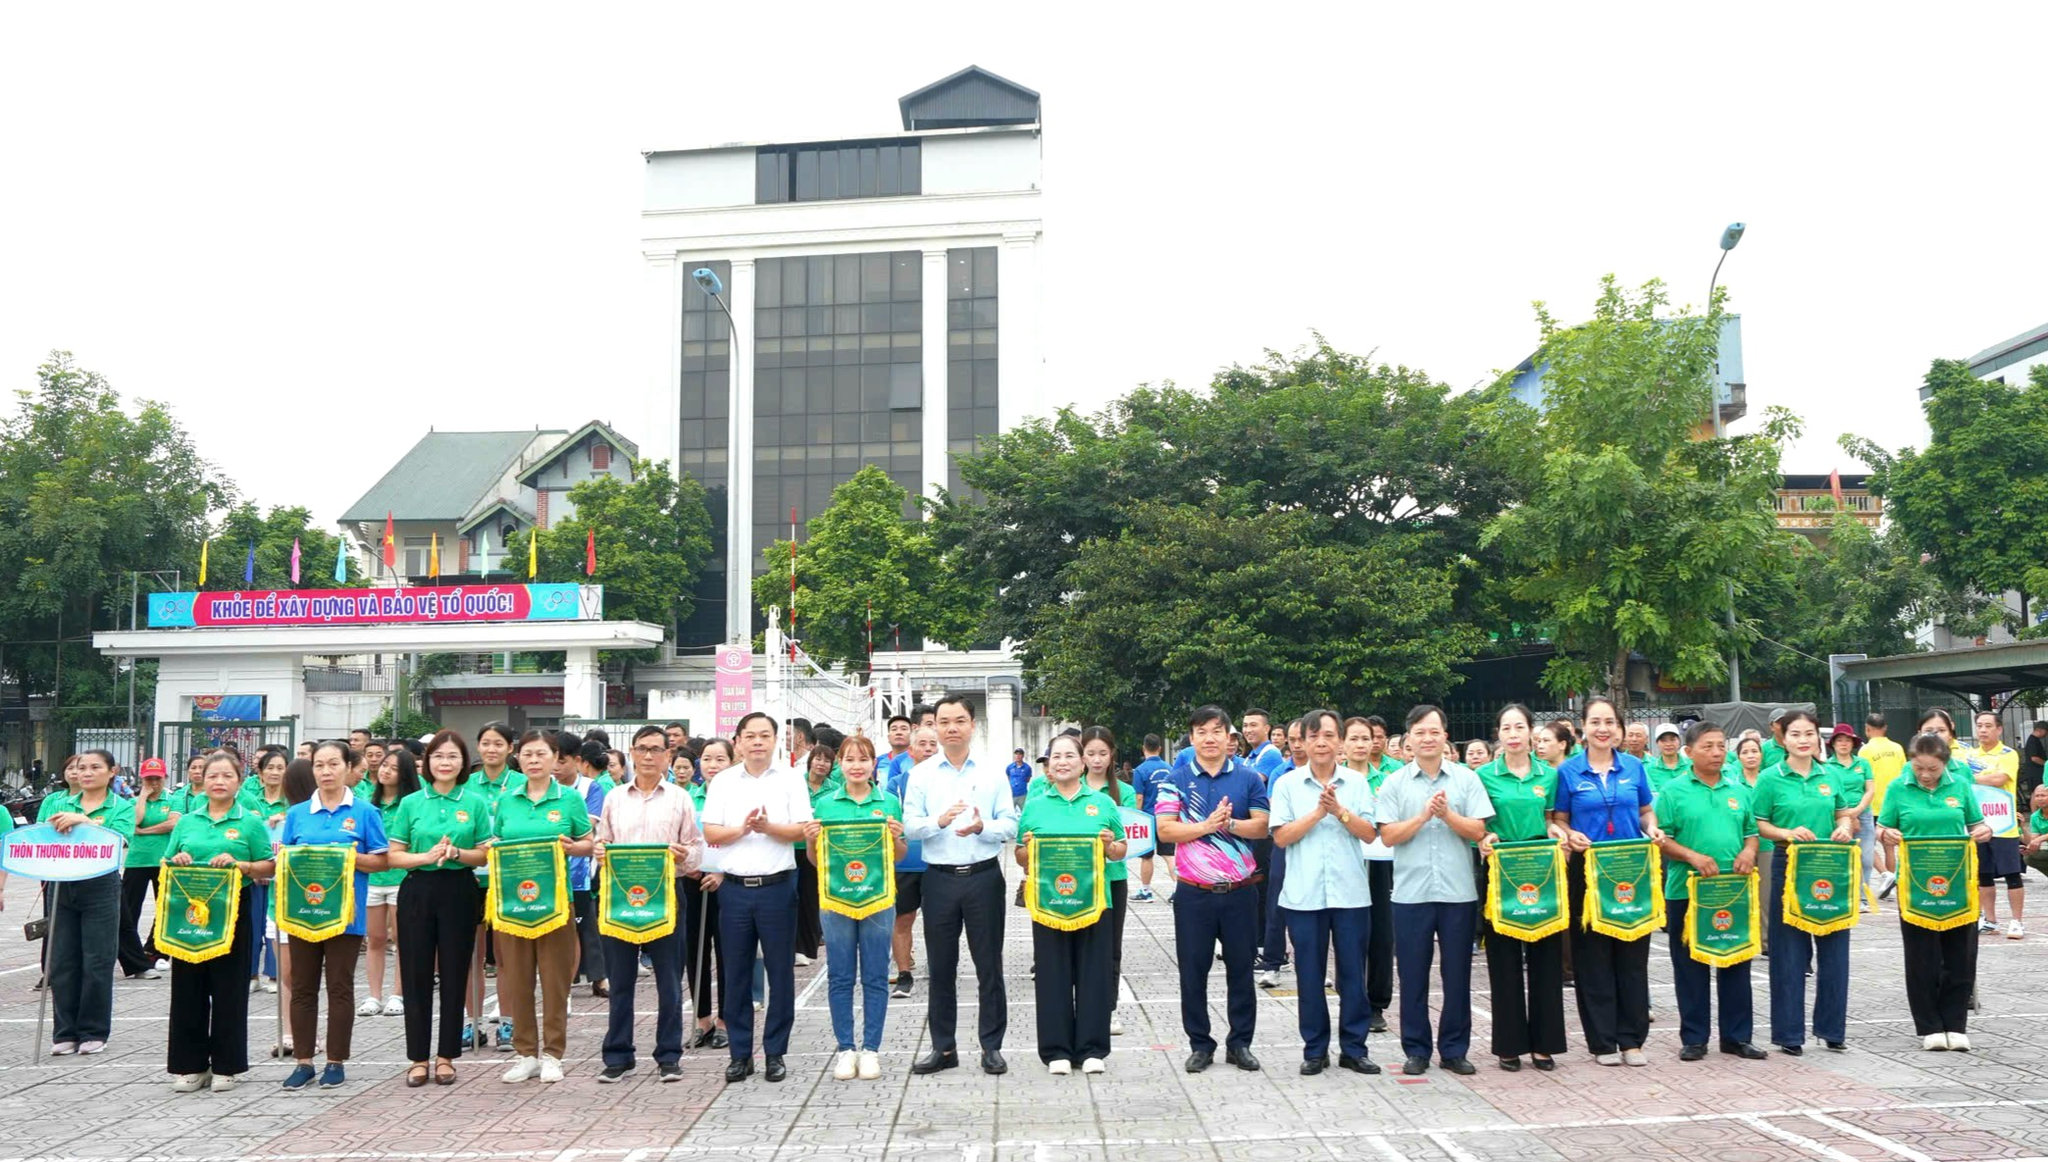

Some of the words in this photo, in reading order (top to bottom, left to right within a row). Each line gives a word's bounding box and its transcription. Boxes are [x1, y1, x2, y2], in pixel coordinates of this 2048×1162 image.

[212, 593, 251, 619] KHỎE
[255, 592, 277, 618] ĐỂ
[279, 595, 309, 618] XÂY
[312, 597, 354, 620] DỰNG
[357, 594, 381, 616] VÀ
[382, 589, 414, 616] BẢO
[418, 593, 438, 619] VỆ
[441, 589, 462, 615] TỔ
[465, 588, 514, 616] QUỐC!
[1982, 803, 2008, 816] QUAN
[9, 842, 33, 859] THÔN
[36, 844, 71, 862] THƯỢNG
[73, 842, 98, 859] ĐÔNG
[100, 844, 114, 859] DƯ
